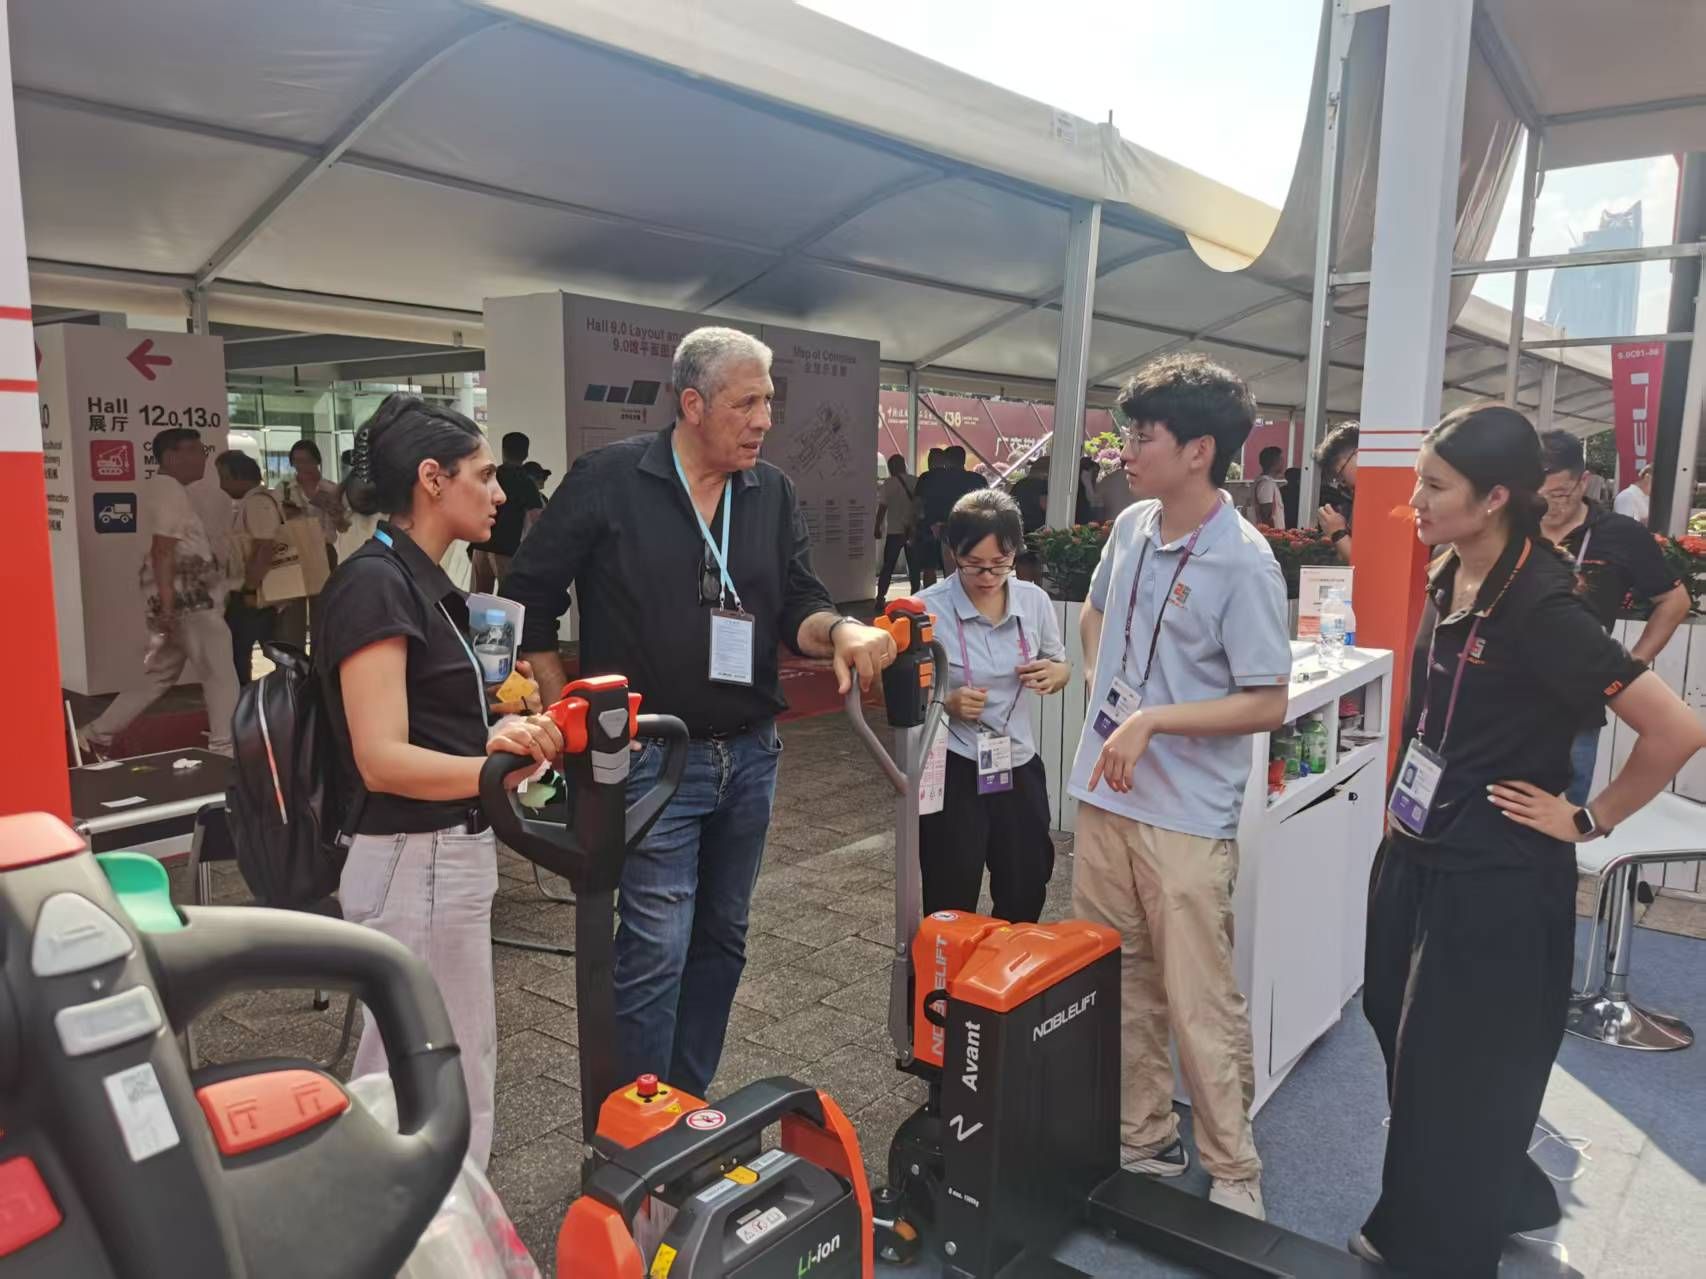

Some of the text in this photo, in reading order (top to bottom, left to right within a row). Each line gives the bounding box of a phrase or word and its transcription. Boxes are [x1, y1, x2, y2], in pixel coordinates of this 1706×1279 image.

[87, 397, 128, 414] Hall
[88, 414, 129, 432] 展厅
[1032, 990, 1097, 1041] NOBLELIFT
[961, 1020, 981, 1092] Avant
[798, 1234, 841, 1276] Li-ion
